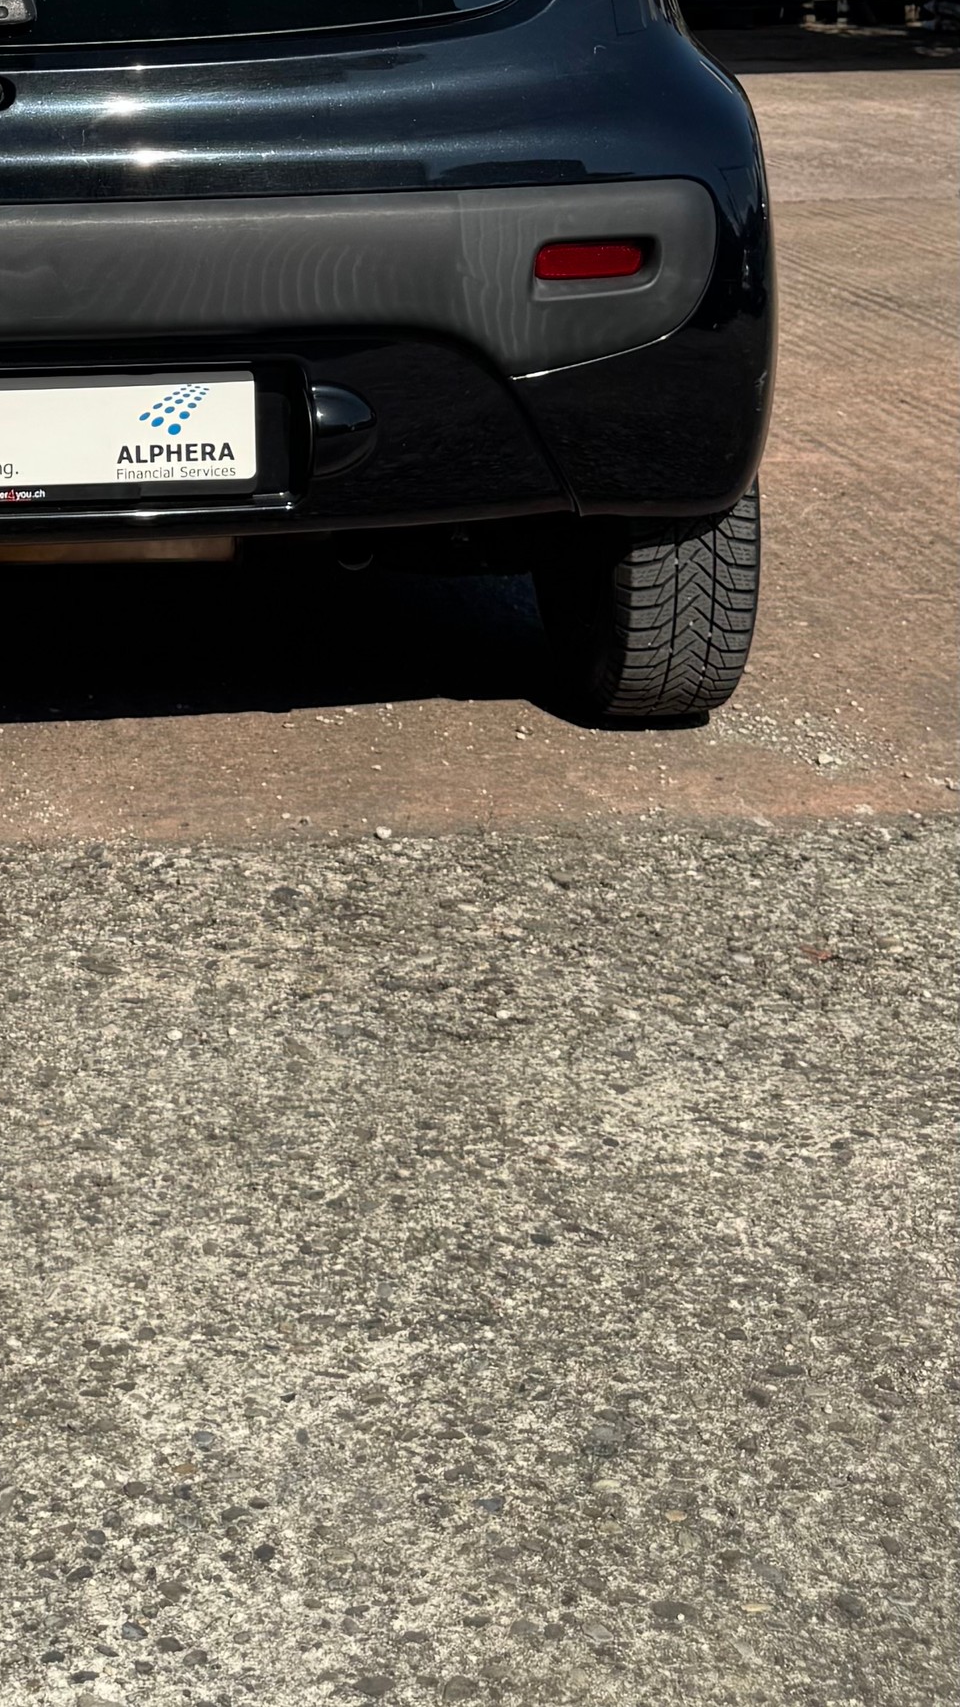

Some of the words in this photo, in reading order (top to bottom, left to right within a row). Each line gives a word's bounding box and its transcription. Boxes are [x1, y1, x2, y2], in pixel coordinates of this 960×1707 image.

[117, 442, 235, 464] ALPHERA
[116, 467, 174, 480] Financial
[180, 466, 236, 478] Services
